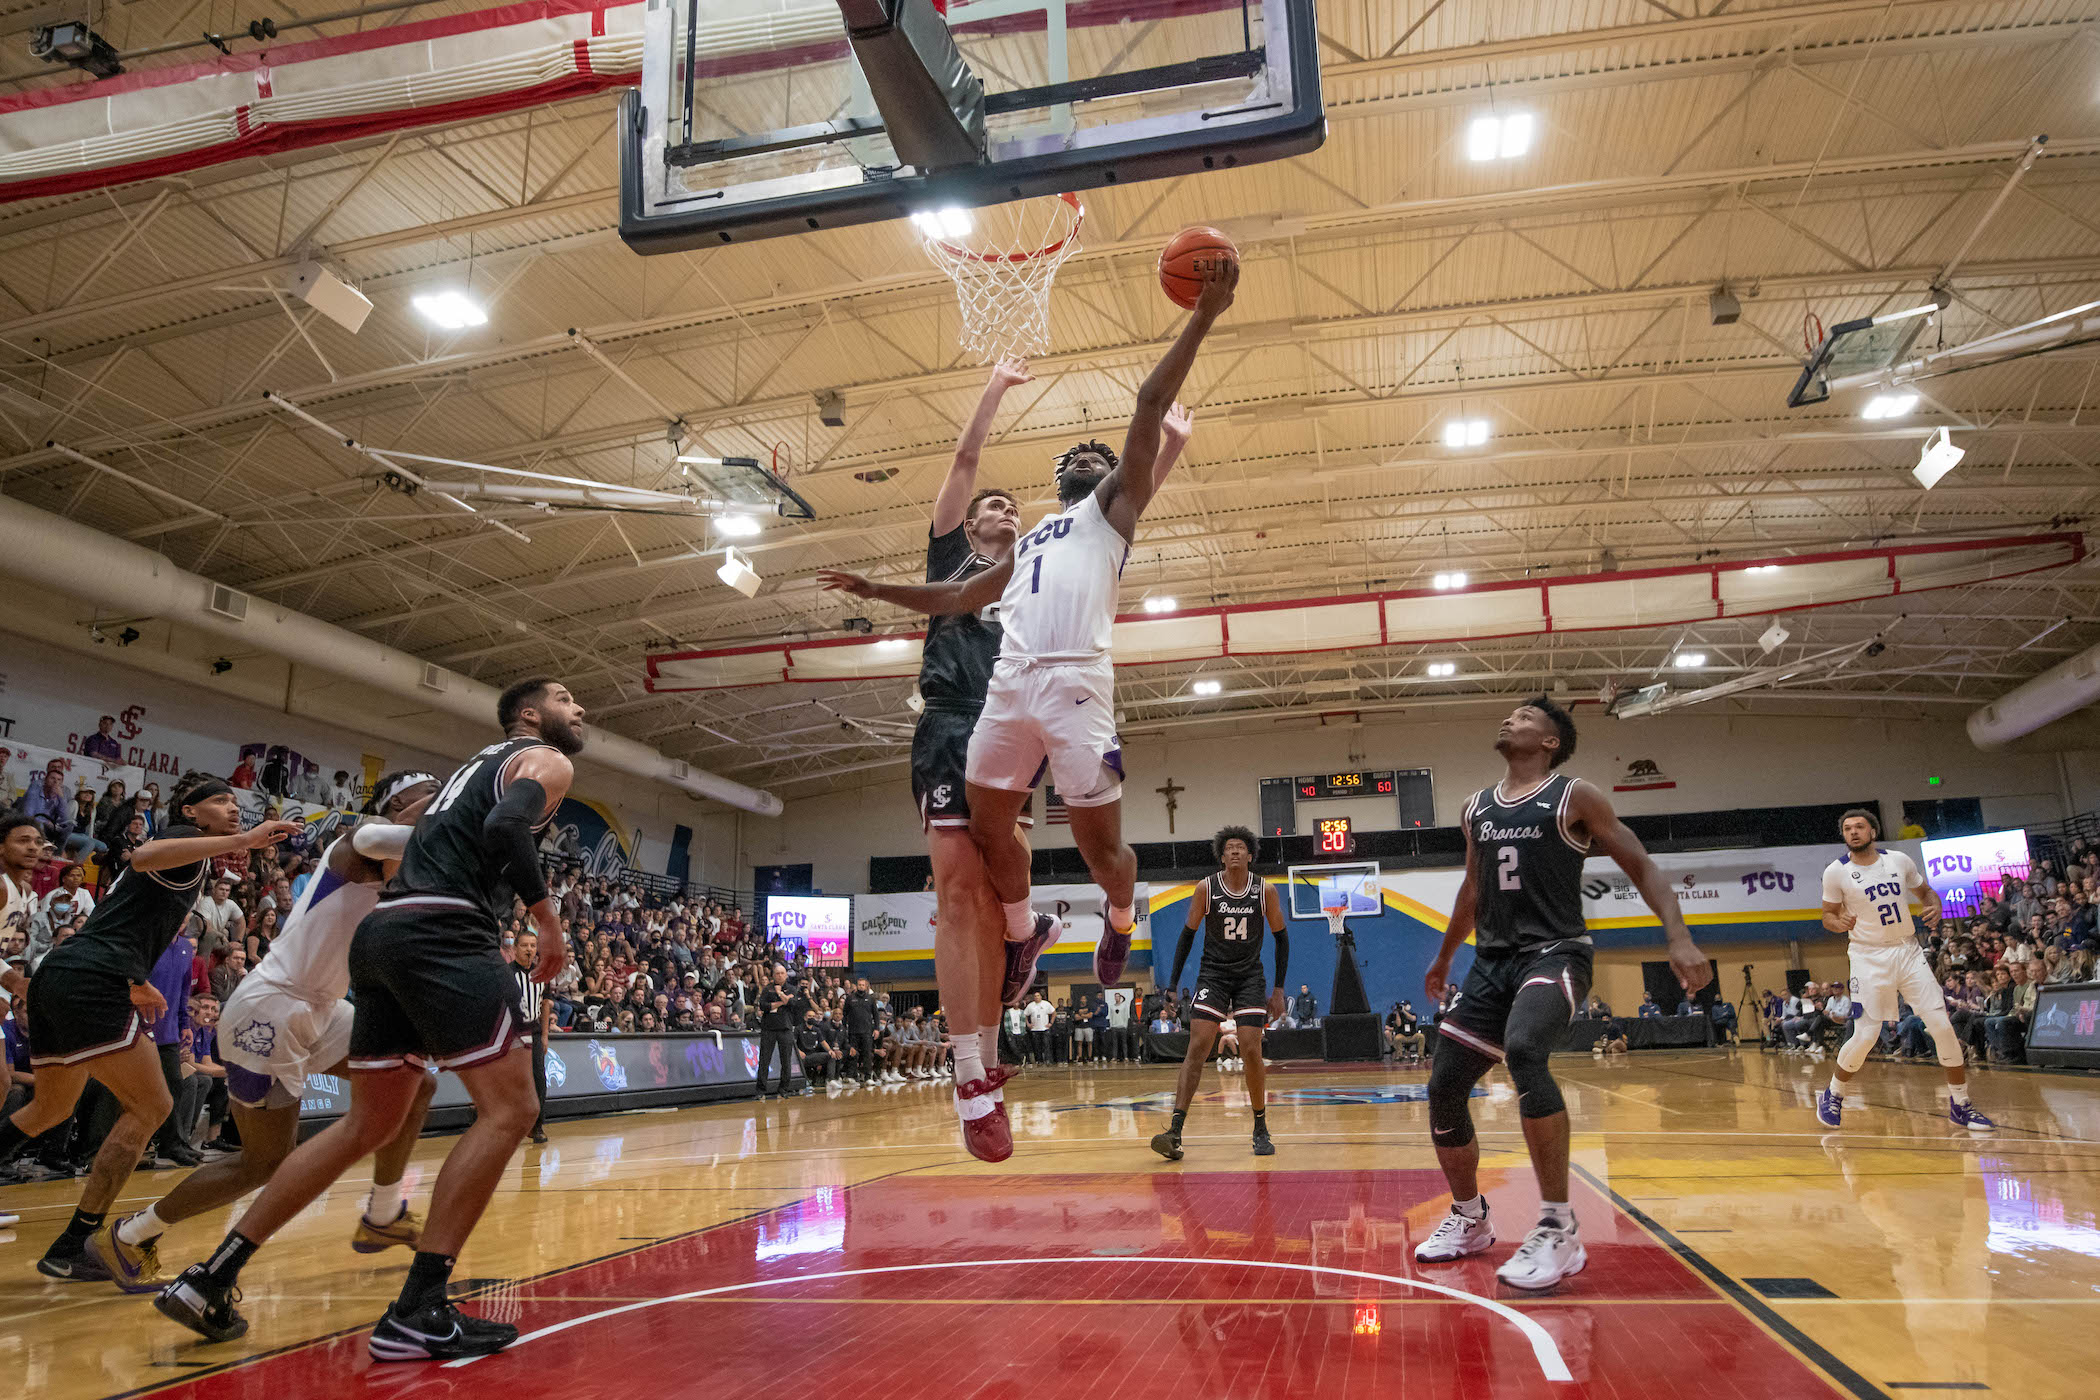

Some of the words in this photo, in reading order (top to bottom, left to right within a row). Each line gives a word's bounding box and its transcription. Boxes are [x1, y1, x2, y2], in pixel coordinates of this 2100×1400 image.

[1018, 518, 1073, 558] TCU
[1031, 554, 1043, 594] 1
[128, 746, 180, 776] CLARA
[29, 769, 47, 782] TC
[1332, 774, 1360, 786] 12:56
[1302, 786, 1316, 796] 40
[1377, 781, 1392, 792] 60
[1276, 828, 1282, 836] 2
[1320, 820, 1348, 832] 12:56
[1478, 821, 1543, 841] Broncos
[1322, 831, 1345, 851] 20
[1498, 846, 1521, 890] 2
[1928, 855, 1972, 877] TCU
[1979, 863, 2000, 872] SANTA
[1741, 871, 1794, 896] TCU
[1614, 892, 1638, 900] WEST
[1692, 890, 1720, 899] CLARA
[1865, 882, 1901, 902] TCU
[1945, 888, 1966, 903] 40
[1218, 902, 1254, 914] Broncos
[1878, 902, 1902, 926] 21
[770, 911, 807, 928] TCU
[862, 919, 877, 932] CAL
[888, 918, 907, 929] POLY
[1224, 917, 1248, 940] 24
[780, 940, 796, 954] 40
[821, 941, 837, 954] 60
[300, 1098, 332, 1110] ANGS
